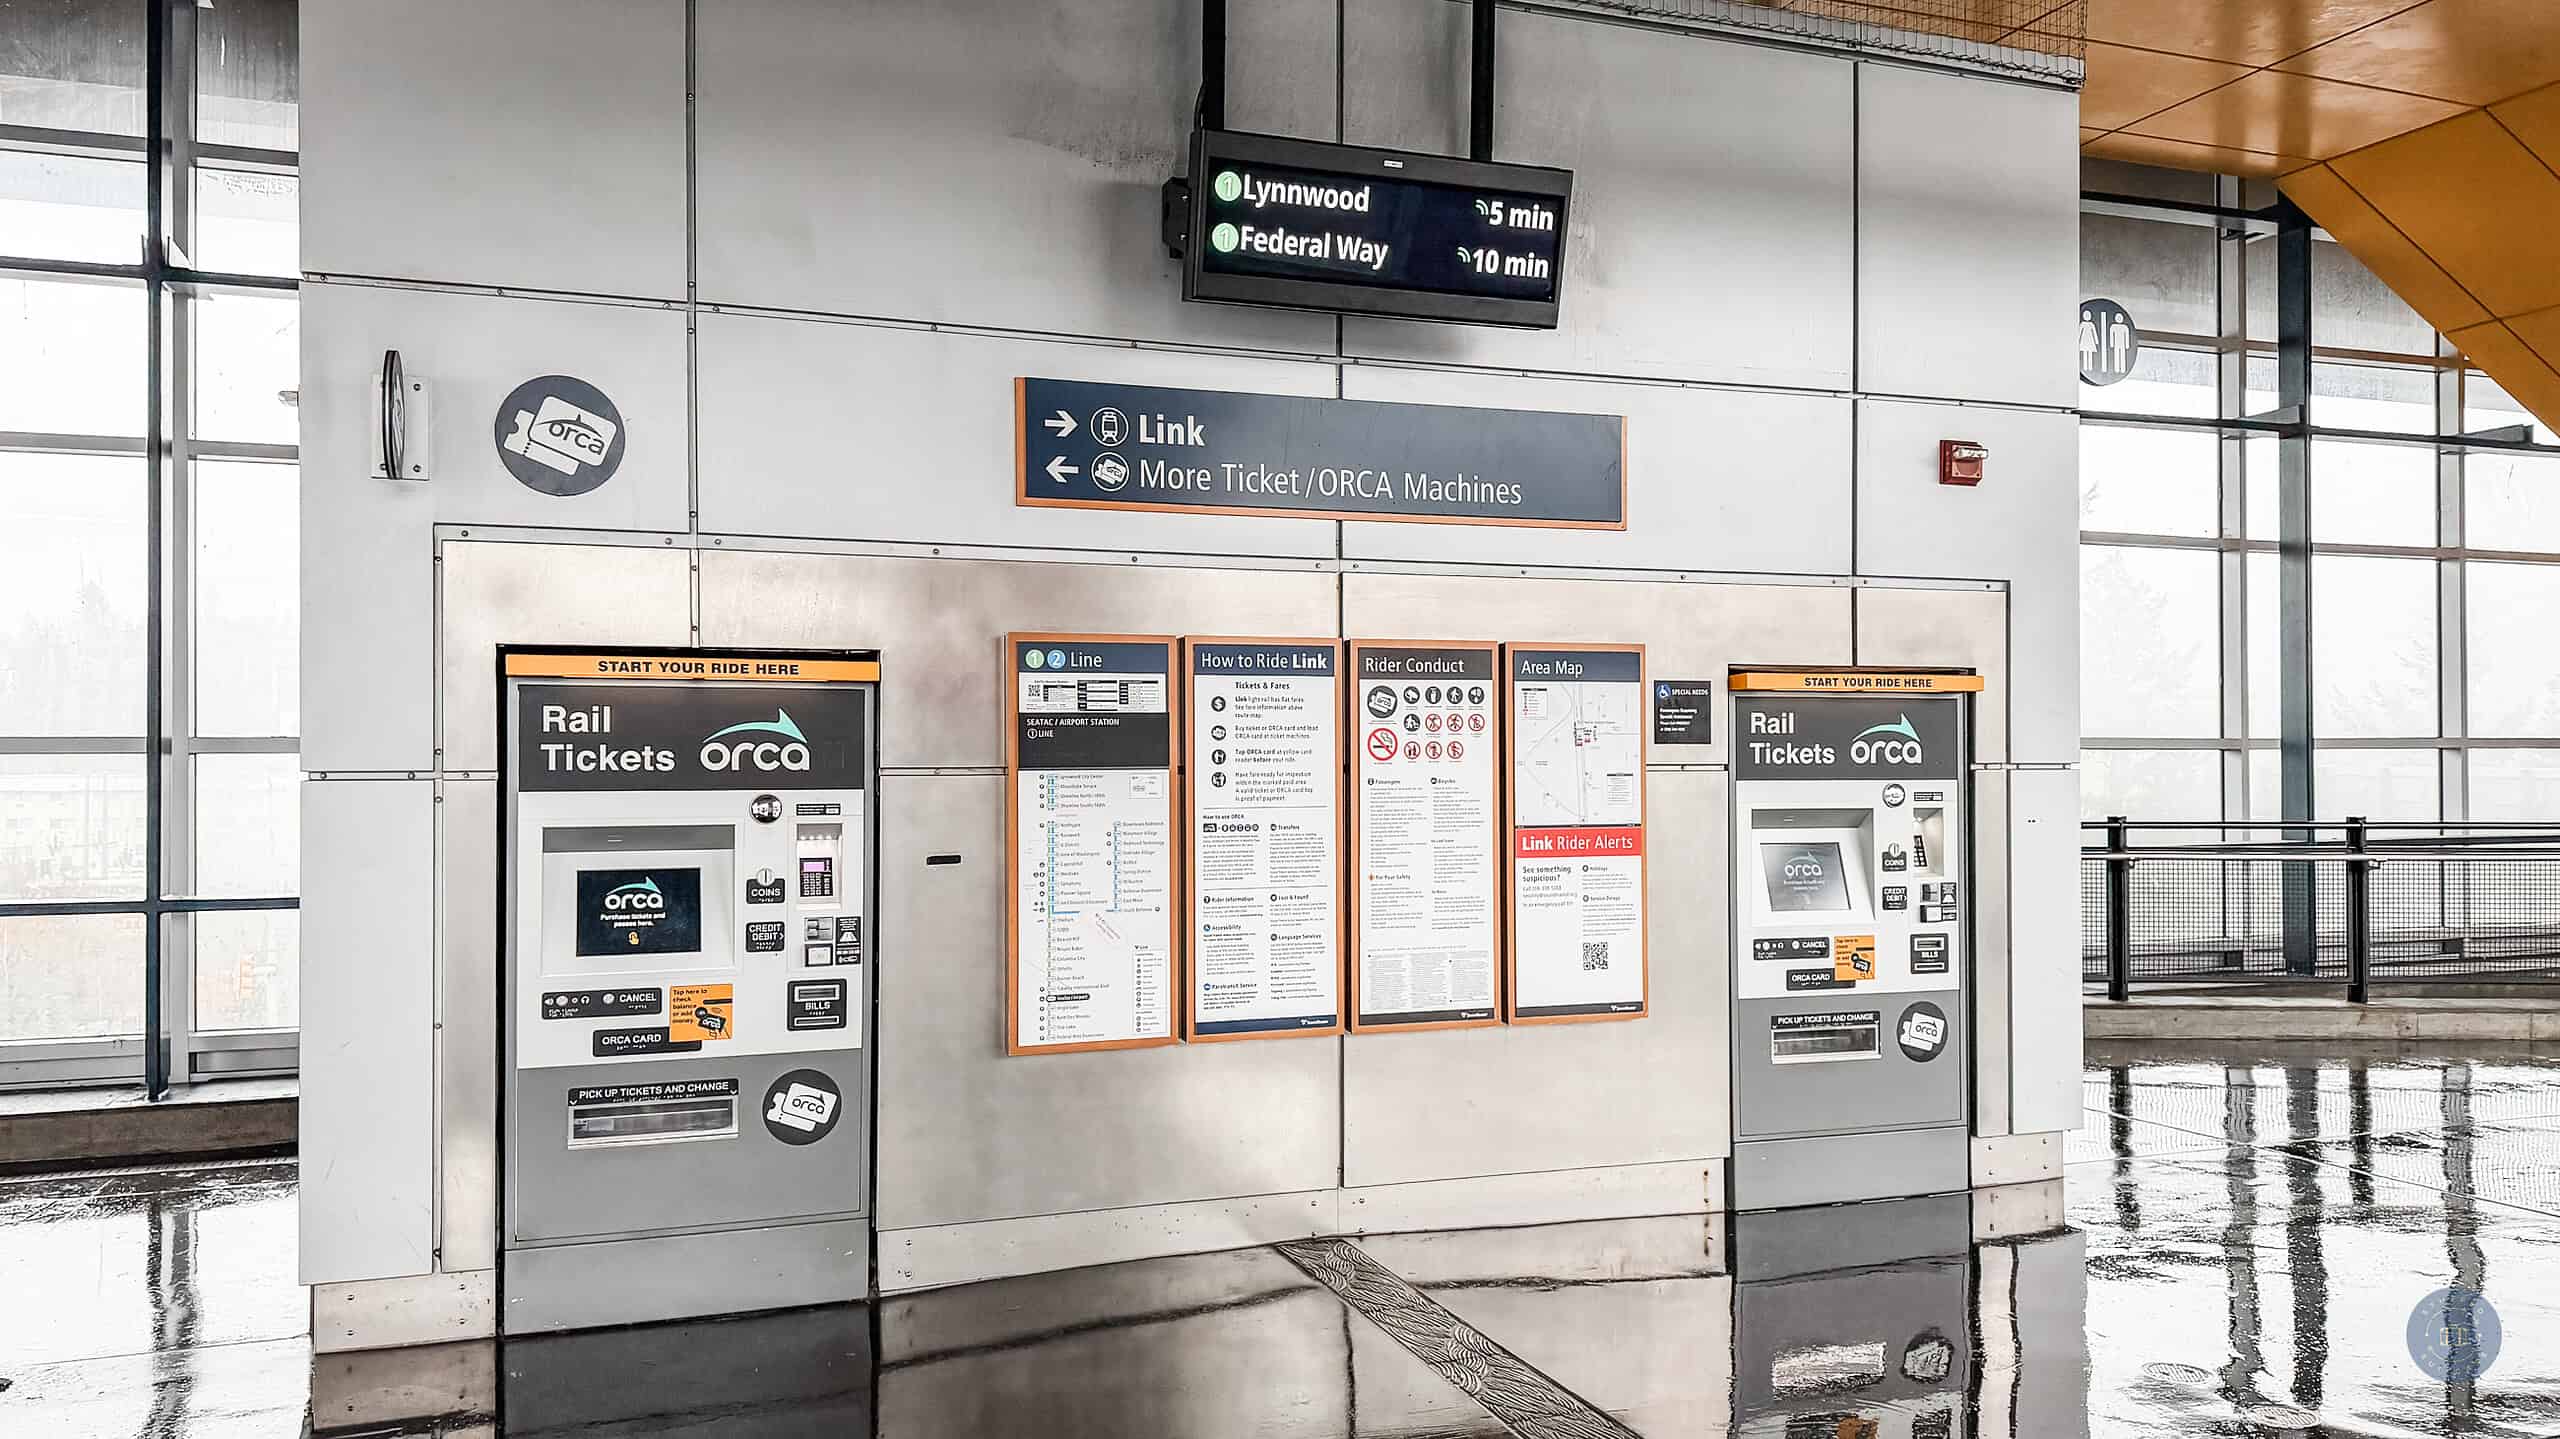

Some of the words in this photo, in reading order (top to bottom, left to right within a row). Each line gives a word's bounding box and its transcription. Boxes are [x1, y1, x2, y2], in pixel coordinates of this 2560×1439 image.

[1243, 175, 1370, 213] Lynnwood
[1489, 204, 1503, 226] 5
[1509, 205, 1554, 231] min
[1240, 226, 1329, 258] Federal
[1337, 235, 1389, 270] Way
[1473, 252, 1498, 274] 10
[1505, 252, 1549, 278] min
[549, 422, 606, 456] orca
[1138, 415, 1206, 447] Link
[1140, 460, 1211, 491] More
[1404, 472, 1522, 505] Machines
[598, 660, 651, 674] START
[660, 661, 705, 674] YOUR
[711, 662, 749, 674] RIDE
[756, 663, 799, 675] HERE
[1071, 652, 1103, 668] Line
[1201, 653, 1234, 668] How
[1238, 654, 1253, 668] to
[1256, 653, 1288, 668] Ride
[1292, 653, 1328, 669] Link
[1366, 657, 1401, 672] Rider
[1406, 657, 1465, 673] Conduct
[1521, 660, 1550, 674] Area
[1555, 660, 1583, 678] Map
[1235, 681, 1260, 689] Tickets
[1805, 678, 1839, 687] START
[1842, 678, 1872, 687] YOUR
[1875, 678, 1901, 687] RIDE
[1904, 679, 1932, 687] HERE
[1026, 718, 1053, 726] SEATAC
[1059, 718, 1088, 726] AIRPORT
[1090, 718, 1120, 726] STATION
[542, 705, 611, 733] Rail
[700, 742, 810, 772] orca
[1750, 712, 1794, 734] Rail
[1850, 740, 1923, 764] orca
[541, 743, 676, 772] Tickets
[1750, 742, 1836, 765] Tickets
[1522, 836, 1553, 851] Link
[1557, 835, 1591, 850] Rider
[1594, 834, 1633, 849] Alerts
[1784, 864, 1822, 876] orca
[751, 887, 781, 897] COINS
[604, 893, 664, 910] orca
[749, 923, 782, 933] CREDIT
[752, 931, 778, 941] DEBIT
[1802, 941, 1827, 949] CANCEL
[1791, 973, 1810, 982] ORCA
[1811, 972, 1831, 981] CARD
[619, 992, 656, 1003] CANCEL
[804, 1001, 831, 1011] BILLS
[1778, 1017, 1792, 1025] PICK
[1804, 1015, 1831, 1024] TICKETS
[1833, 1014, 1846, 1022] AND
[1847, 1013, 1874, 1022] CHANGE
[1915, 1024, 1938, 1037] orca
[601, 1036, 631, 1046] ORCA
[632, 1033, 662, 1044] CARD
[579, 1088, 603, 1100] PICK
[604, 1088, 618, 1098] UP
[619, 1085, 663, 1098] TICKETS
[664, 1083, 685, 1095] AND
[687, 1080, 729, 1093] CHANGE
[792, 1096, 825, 1116] orca
